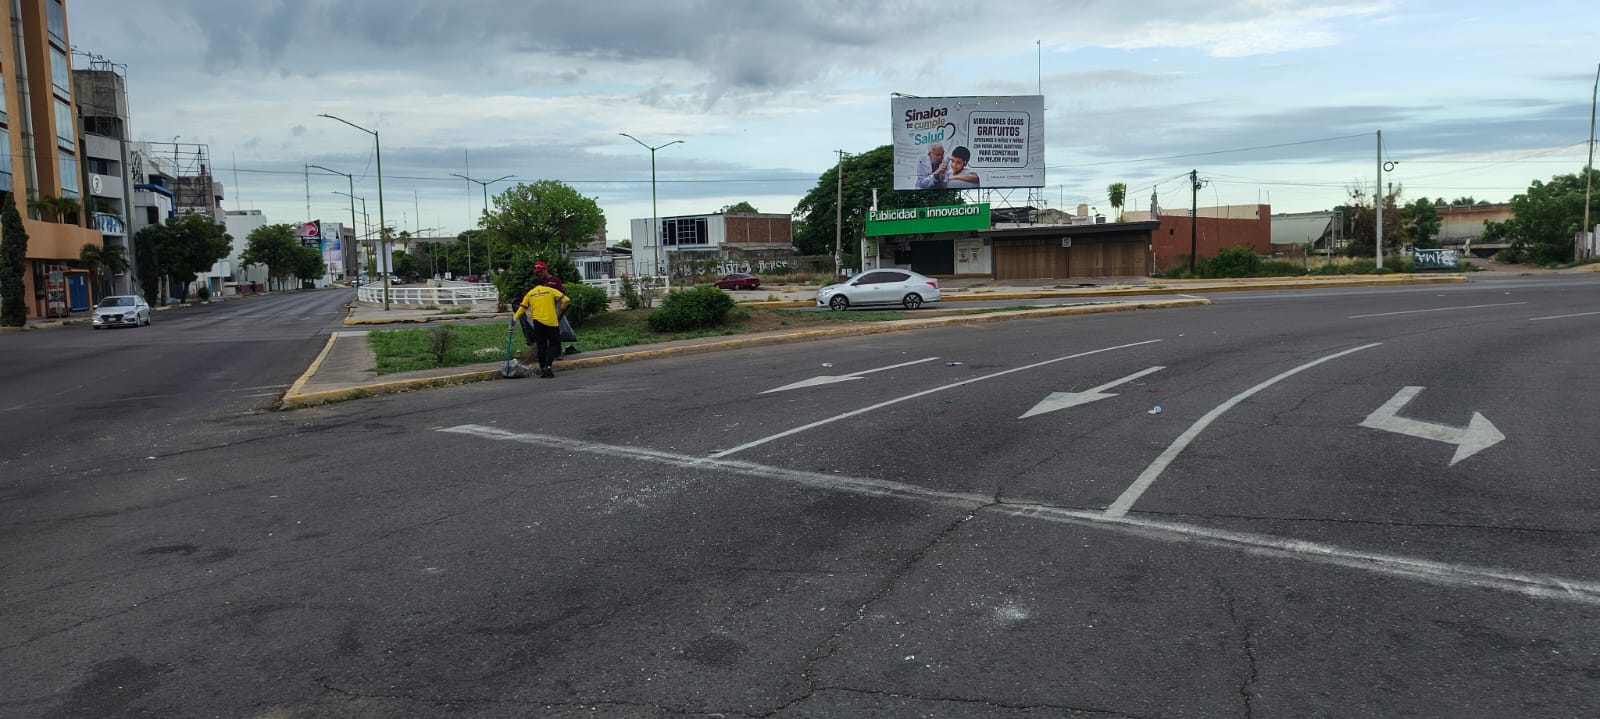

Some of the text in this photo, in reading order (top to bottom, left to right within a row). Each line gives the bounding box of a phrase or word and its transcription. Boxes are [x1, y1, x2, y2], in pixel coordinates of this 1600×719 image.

[905, 107, 948, 122] Sinaloa
[914, 118, 946, 129] cumple
[914, 129, 945, 145] Salud
[977, 126, 1020, 136] GRATUITOS
[869, 208, 917, 221] Publicidad
